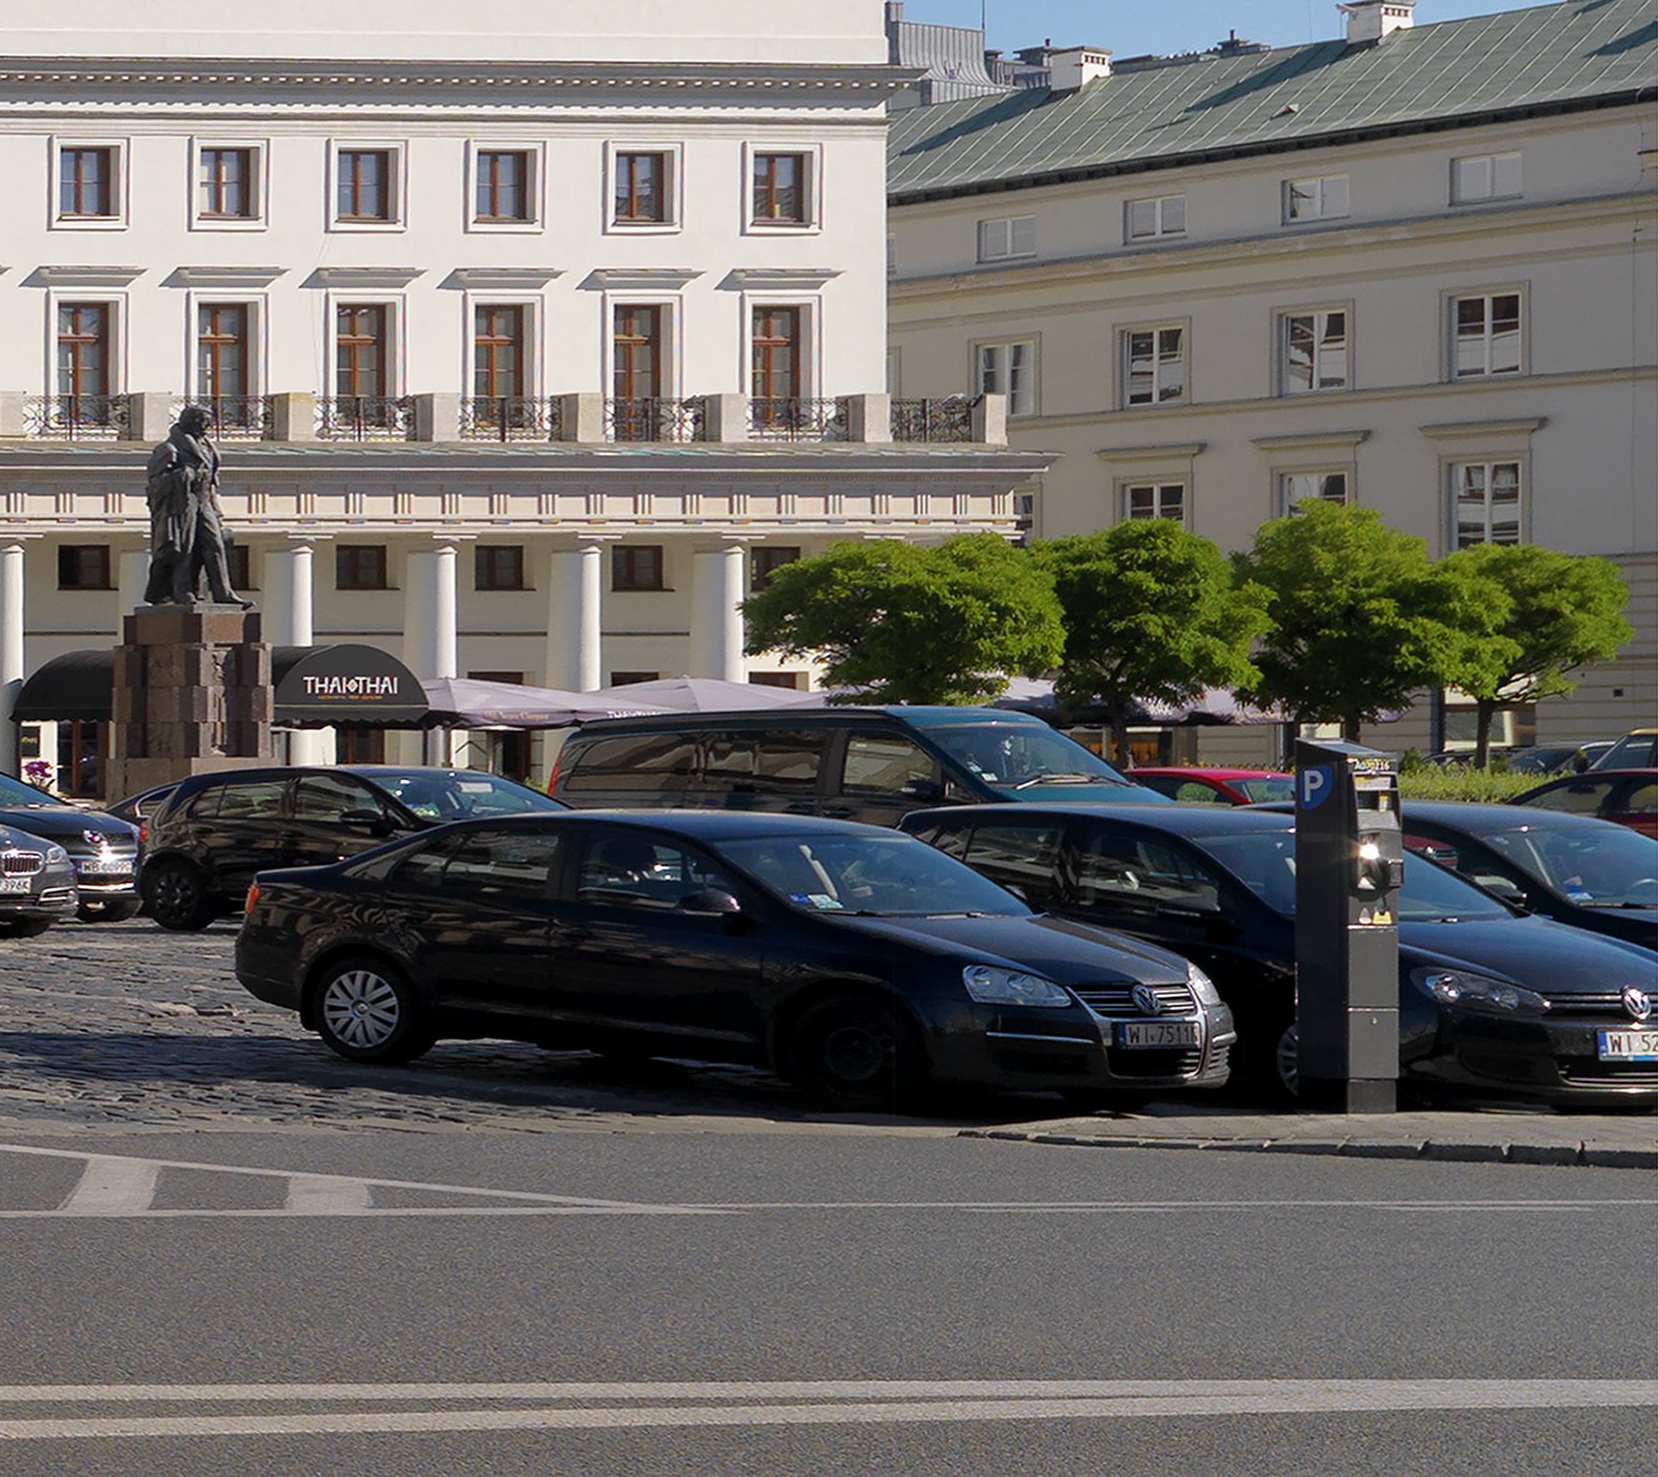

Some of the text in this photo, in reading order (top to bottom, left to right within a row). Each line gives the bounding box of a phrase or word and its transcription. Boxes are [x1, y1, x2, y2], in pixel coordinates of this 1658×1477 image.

[303, 676, 398, 695] THAI THAI
[1304, 770, 1324, 803] P
